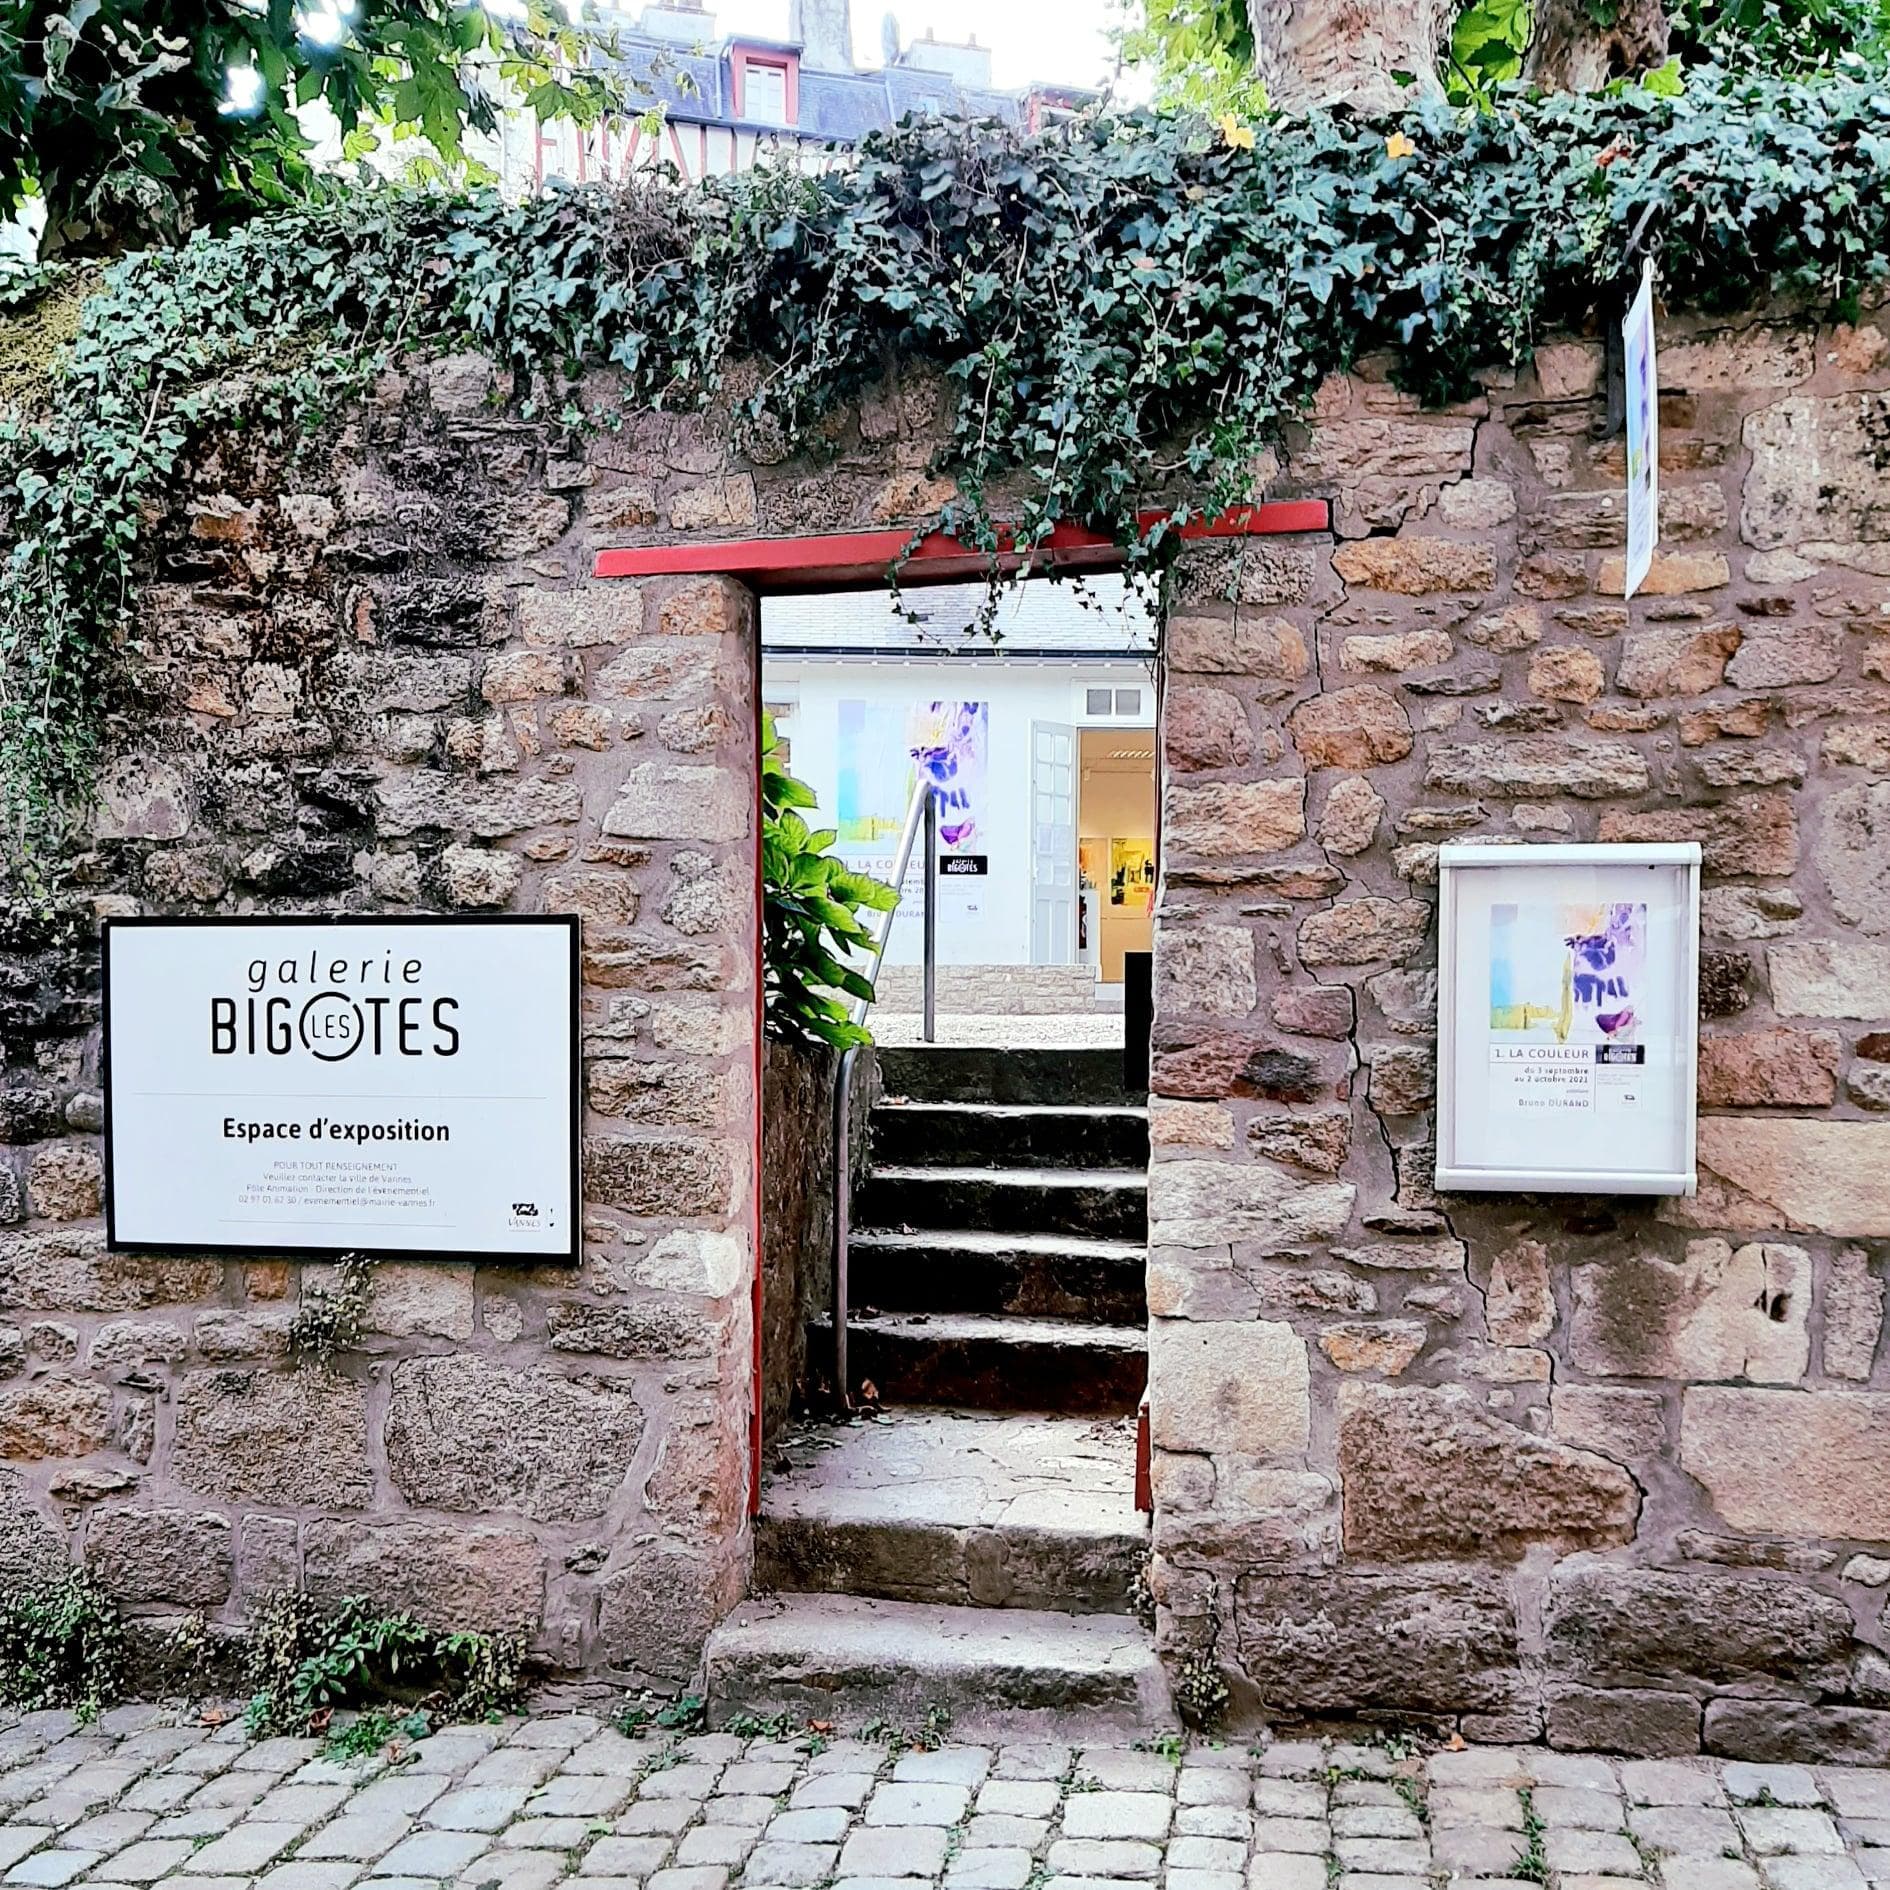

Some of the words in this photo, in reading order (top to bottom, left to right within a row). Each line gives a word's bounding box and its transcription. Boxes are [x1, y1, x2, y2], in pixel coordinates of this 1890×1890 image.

[247, 949, 422, 993] galerie
[311, 1014, 350, 1039] LES
[1509, 1048, 1524, 1059] LA
[1528, 1048, 1589, 1059] COULEUR
[1518, 1098, 1546, 1107] Bruno
[1548, 1099, 1589, 1108] DURAND
[223, 1117, 301, 1144] Espace
[309, 1118, 450, 1146] d'exposition
[273, 1161, 298, 1170] POUR
[300, 1161, 323, 1170] TOUT
[325, 1161, 398, 1172] RENSEIGNEMENT
[298, 1173, 337, 1182] contacter
[339, 1174, 347, 1182] la
[349, 1174, 367, 1183] ville
[369, 1174, 380, 1183] de
[381, 1174, 412, 1184] Vannes
[266, 1184, 309, 1193] Animation
[315, 1185, 353, 1194] Direction
[355, 1185, 366, 1194] de
